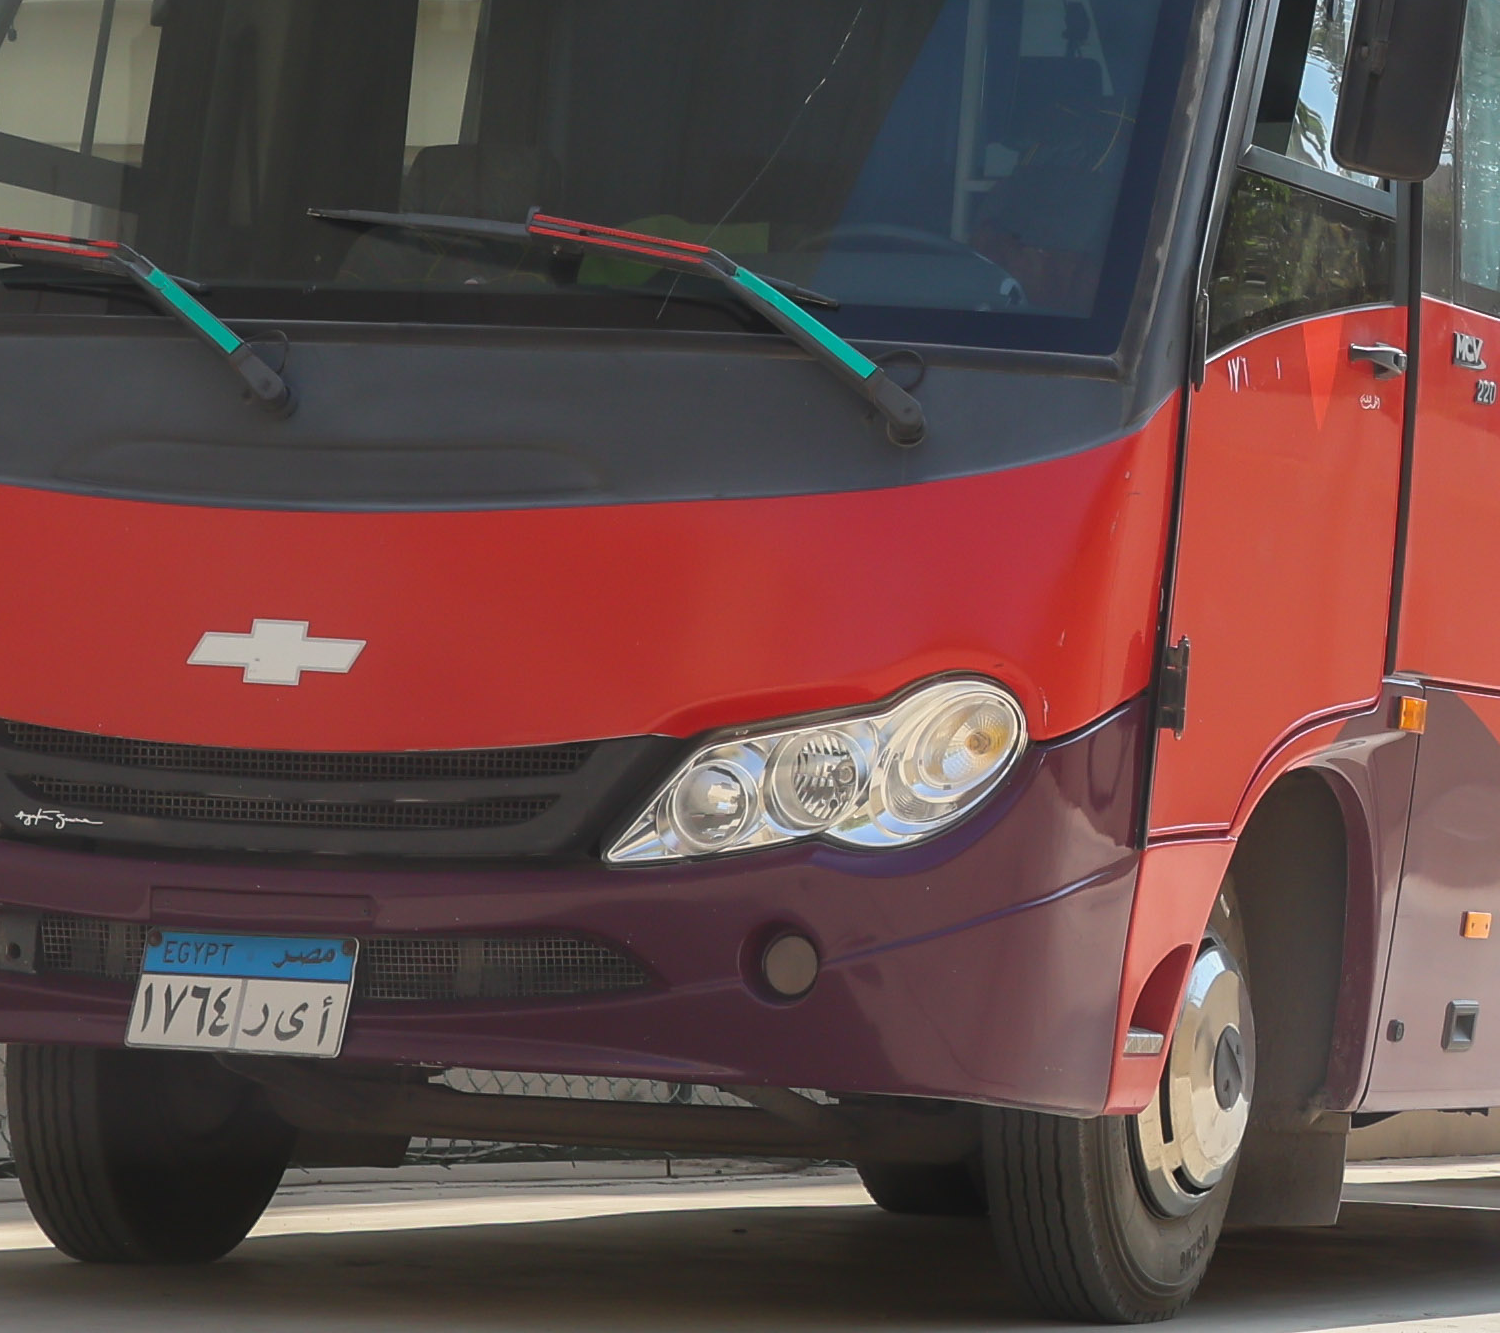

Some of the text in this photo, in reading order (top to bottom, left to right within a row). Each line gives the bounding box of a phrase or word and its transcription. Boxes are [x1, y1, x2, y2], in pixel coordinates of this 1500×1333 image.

[1453, 332, 1484, 364] MCV
[1476, 379, 1497, 405] 220
[162, 940, 234, 965] EGYPT
[271, 945, 337, 969] مصر
[140, 982, 233, 1037] ١٧٦٤
